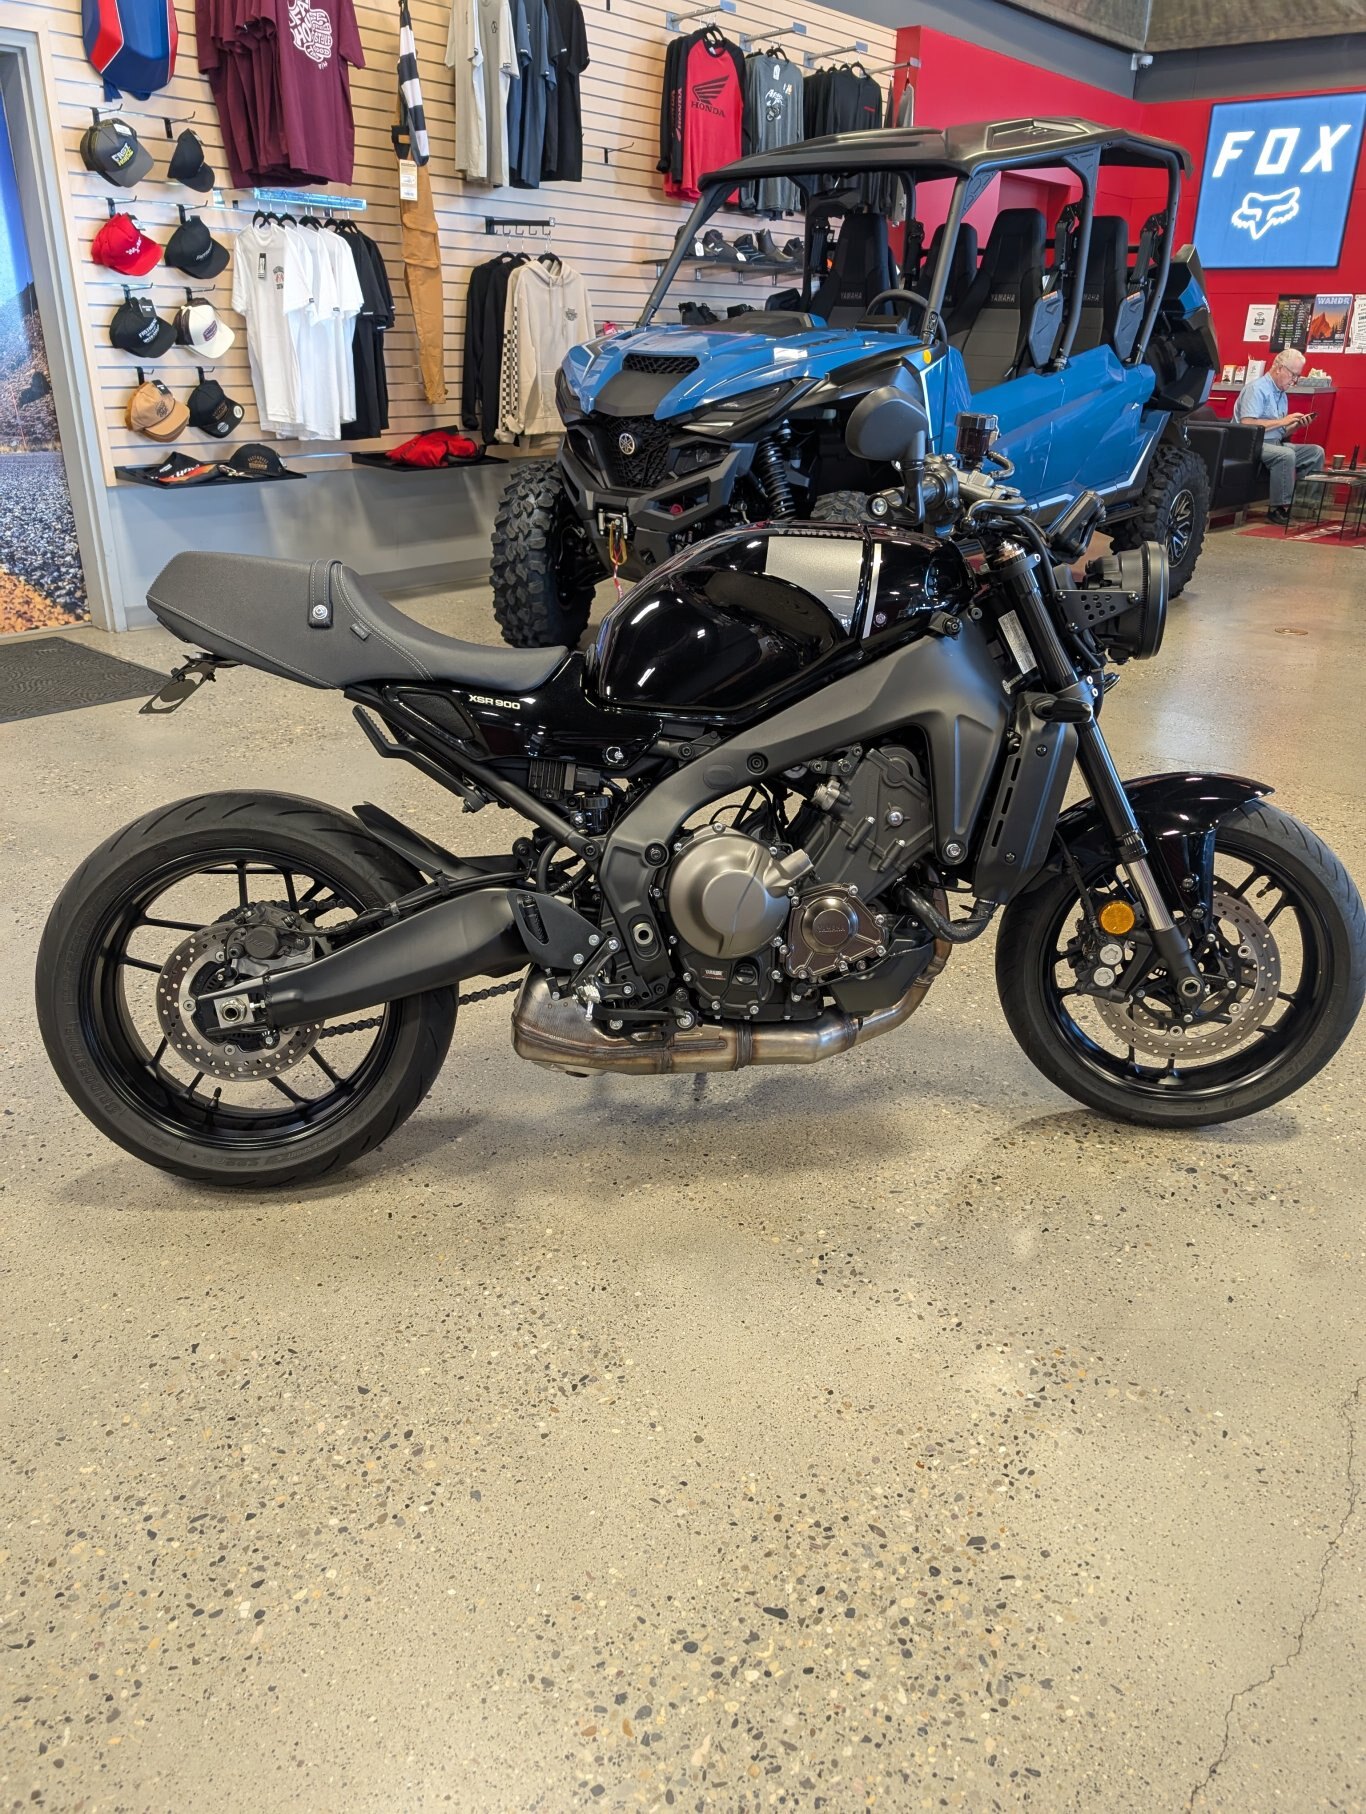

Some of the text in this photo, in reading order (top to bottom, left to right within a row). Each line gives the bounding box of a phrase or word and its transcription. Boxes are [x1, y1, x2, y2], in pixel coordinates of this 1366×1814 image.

[691, 101, 725, 117] HONDA
[1212, 124, 1352, 178] FOX
[840, 292, 862, 300] YAMAHA
[991, 294, 1015, 302] YAMAHA
[469, 694, 521, 710] XSR 900
